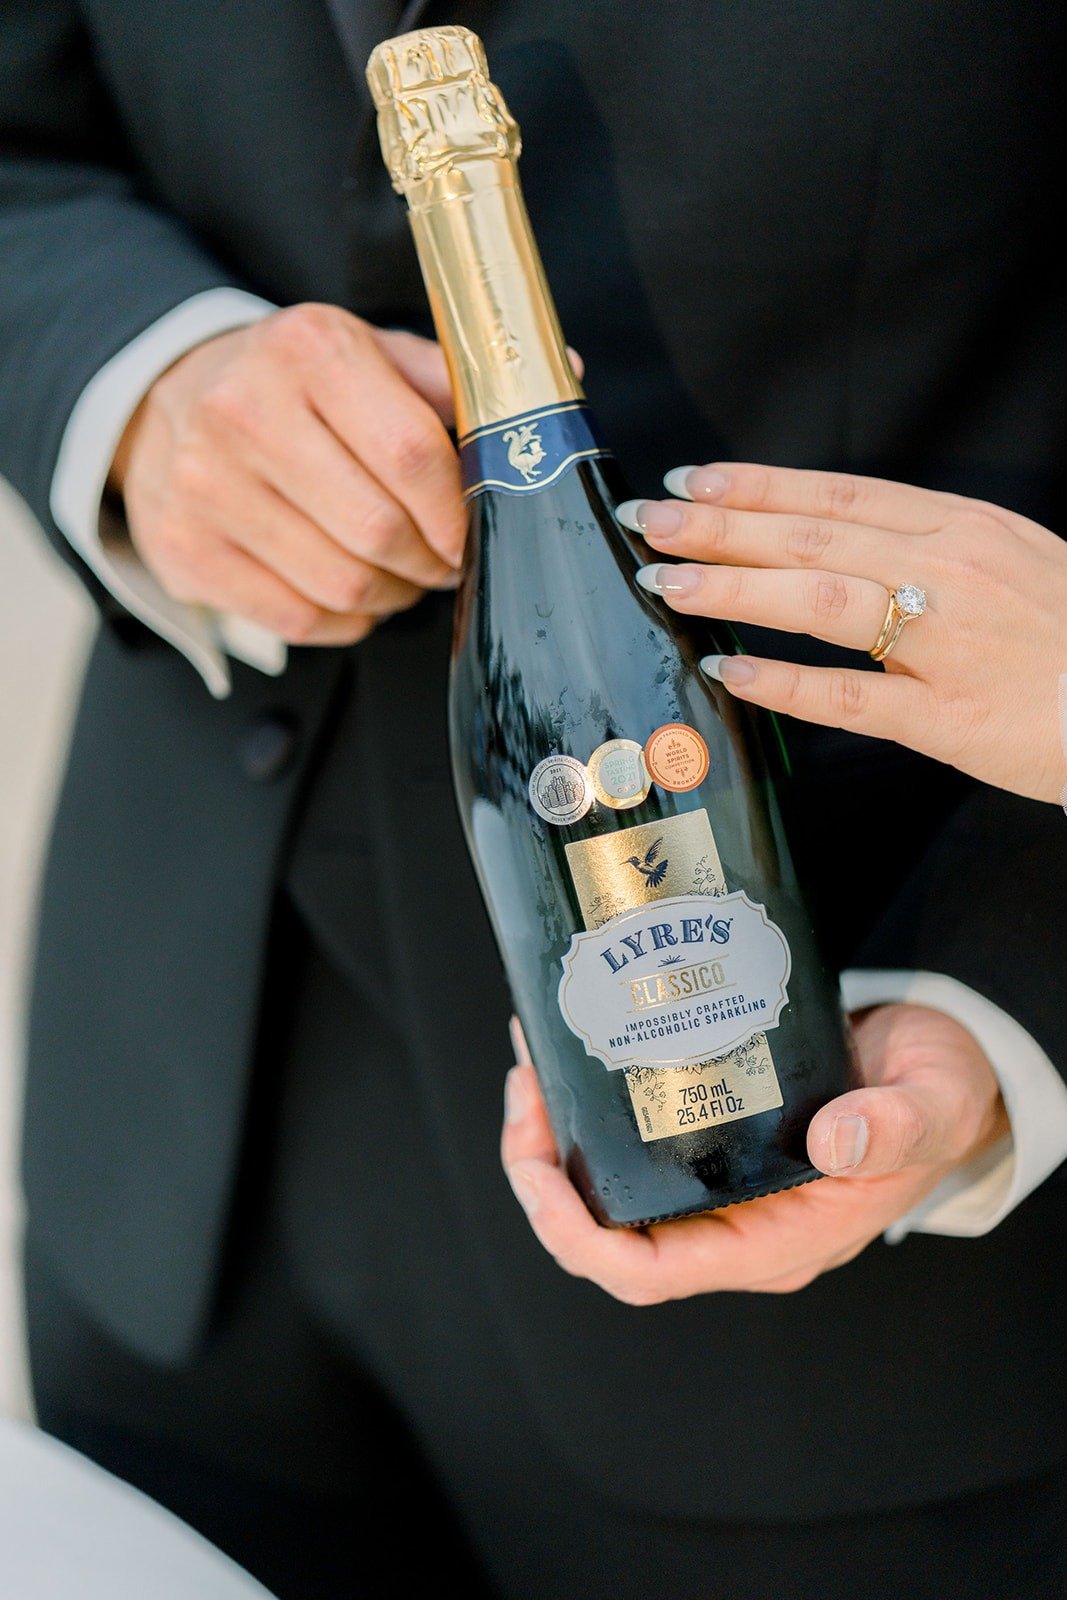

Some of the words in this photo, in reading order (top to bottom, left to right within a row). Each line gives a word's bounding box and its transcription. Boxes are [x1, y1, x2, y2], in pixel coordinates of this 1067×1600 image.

[665, 747, 687, 757] WORLD
[667, 754, 690, 763] SPIRITS
[611, 772, 636, 785] 2021
[673, 774, 695, 785] BRONZE
[600, 914, 731, 974] LYRE'S
[630, 962, 725, 1006] CLASSICO
[609, 1018, 701, 1048] NON-ALCOHOLIC
[705, 999, 767, 1024] SPARKLING
[625, 1009, 692, 1032] IMPOSSIBLY
[696, 994, 745, 1015] CRAFTED
[678, 1084, 706, 1105] 750
[711, 1078, 733, 1097] mL
[677, 1103, 709, 1126] 25.4
[727, 1096, 745, 1112] Oz
